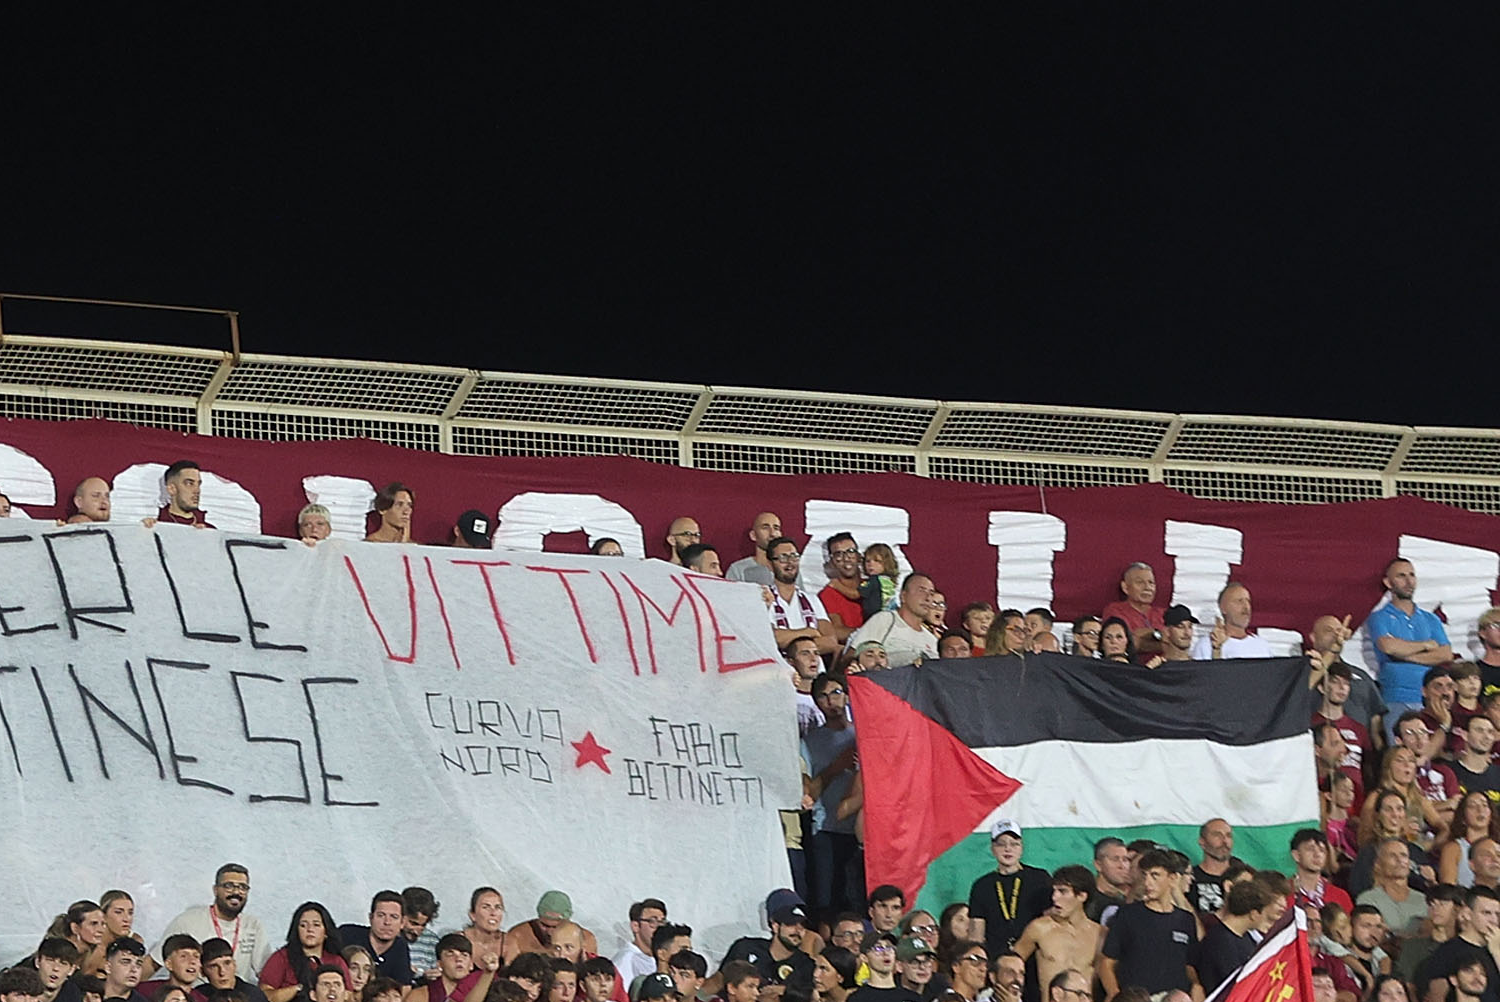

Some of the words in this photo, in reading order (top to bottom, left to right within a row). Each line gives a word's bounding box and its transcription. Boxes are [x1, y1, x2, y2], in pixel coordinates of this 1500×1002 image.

[155, 532, 307, 652] LE
[343, 554, 776, 675] VITTIME
[425, 692, 564, 746] CURVA
[649, 715, 744, 768] FABIO
[440, 745, 553, 783] NORD
[623, 758, 765, 808] BETTINETTI
